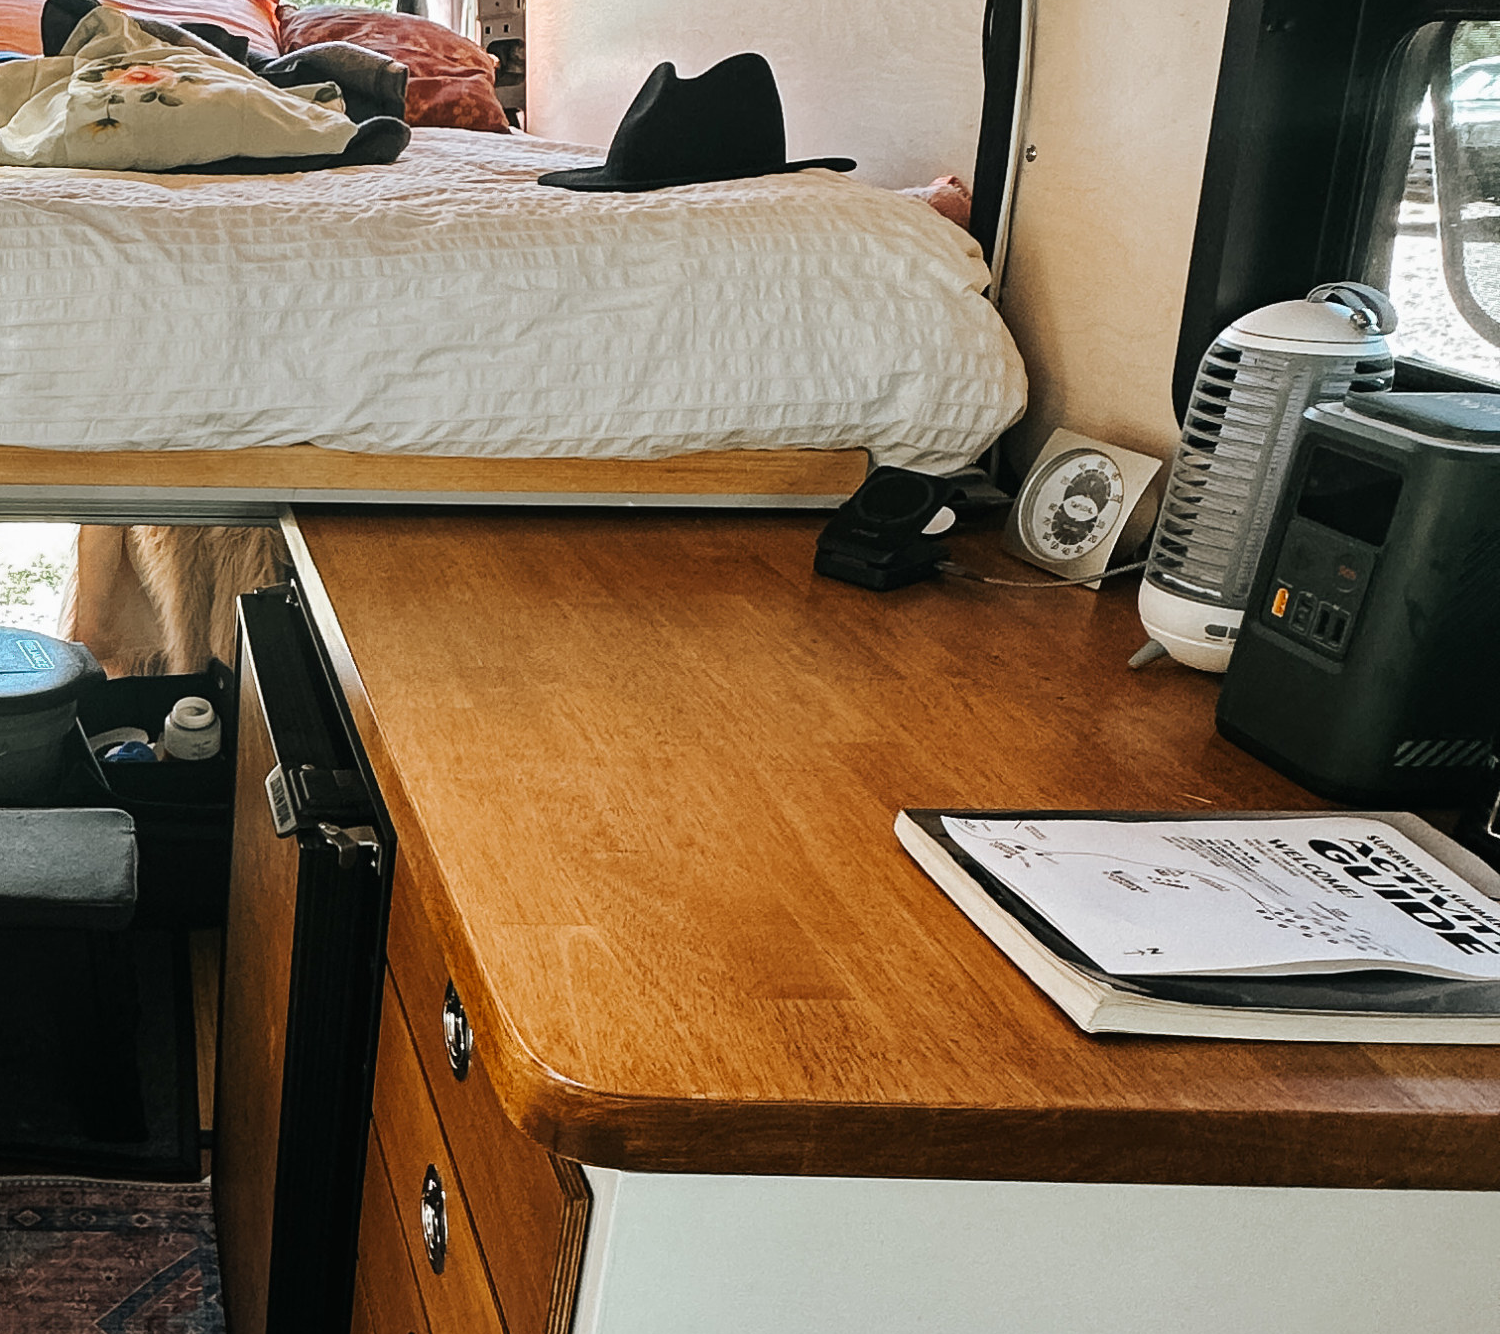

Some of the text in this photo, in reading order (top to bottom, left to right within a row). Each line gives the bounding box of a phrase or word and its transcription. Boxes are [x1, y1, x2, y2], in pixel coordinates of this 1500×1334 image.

[1268, 839, 1365, 899] WELCOME!
[1308, 839, 1500, 955] GUIDE
[1338, 837, 1500, 946] ACTIVIT
